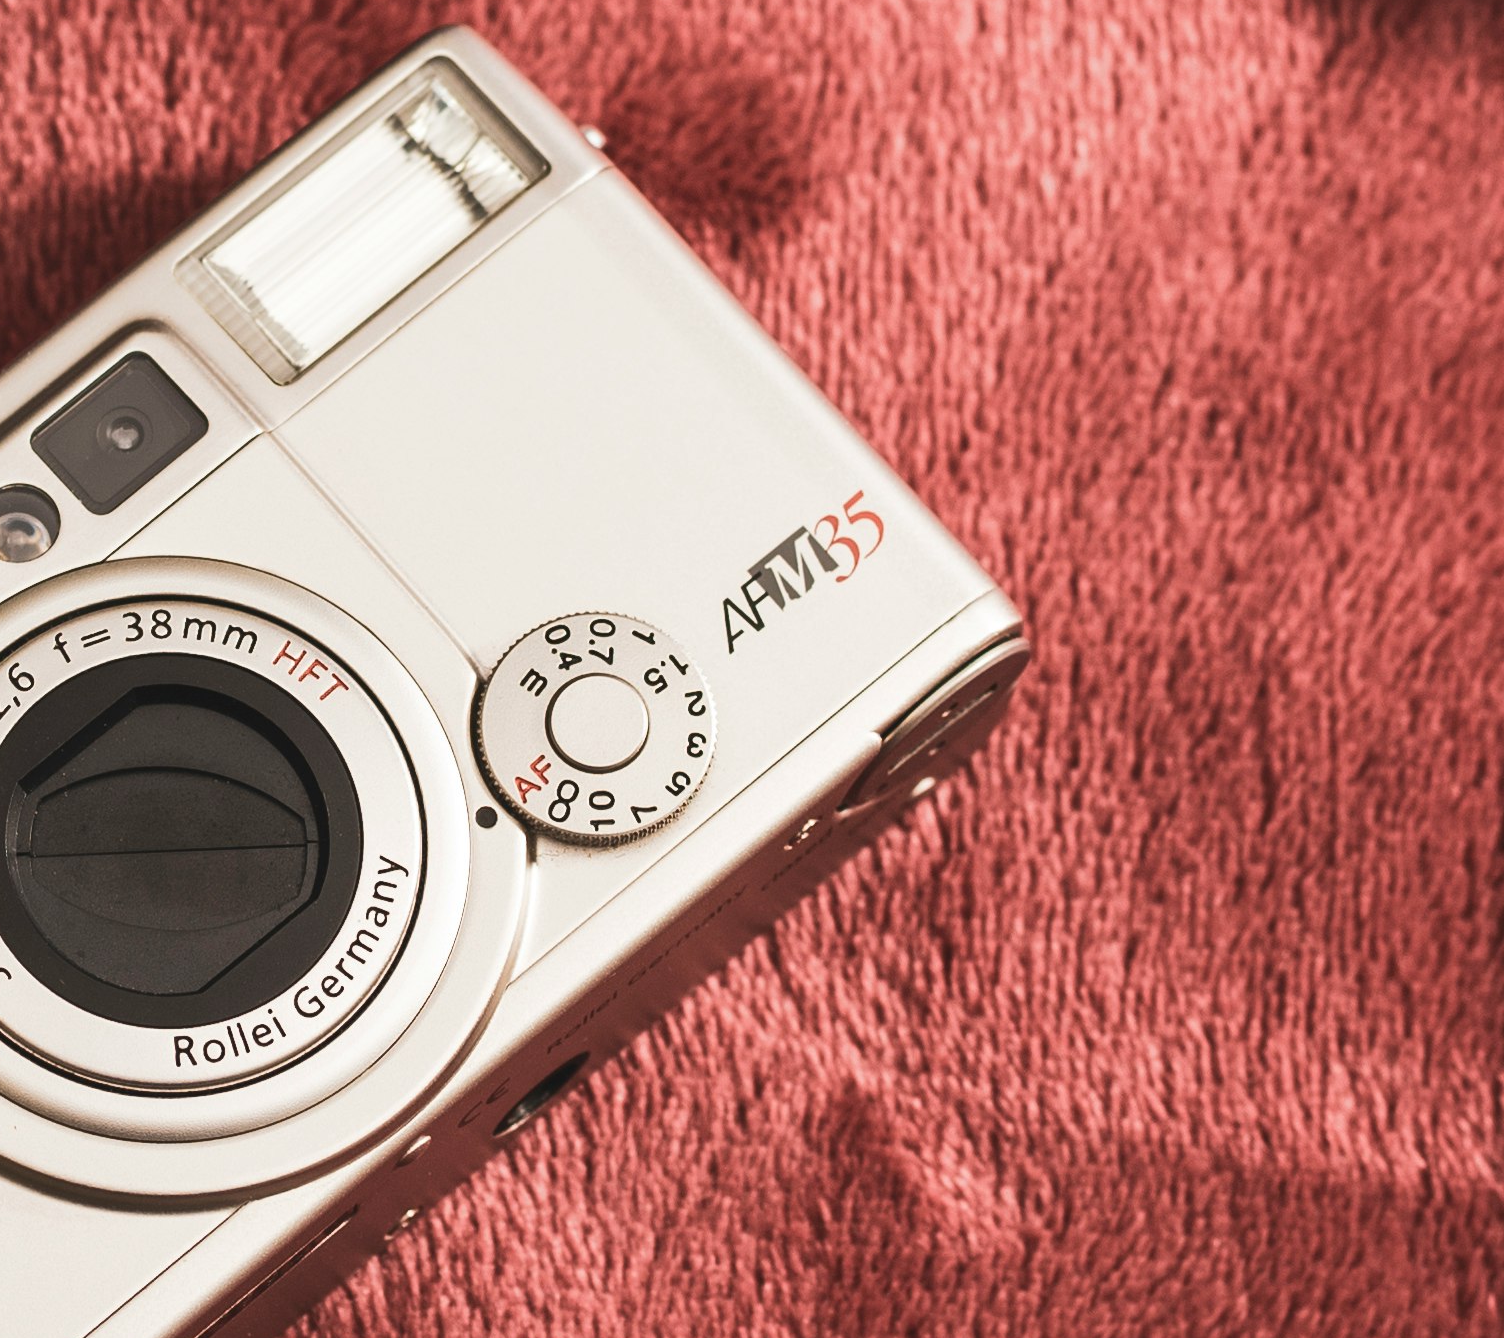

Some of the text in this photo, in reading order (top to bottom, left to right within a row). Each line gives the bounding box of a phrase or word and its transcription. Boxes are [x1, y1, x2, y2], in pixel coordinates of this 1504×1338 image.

[544, 623, 583, 671] 0.4
[588, 617, 617, 666] 0.7
[631, 628, 657, 648] 1
[271, 640, 350, 702] HFT
[642, 653, 690, 695] 1.5
[684, 689, 707, 717] 2
[686, 731, 707, 759] 3
[513, 754, 552, 804] AF
[664, 770, 692, 798] 5
[588, 789, 616, 832] 10
[629, 803, 659, 824] 7
[172, 854, 410, 1069] Rollei Germany
